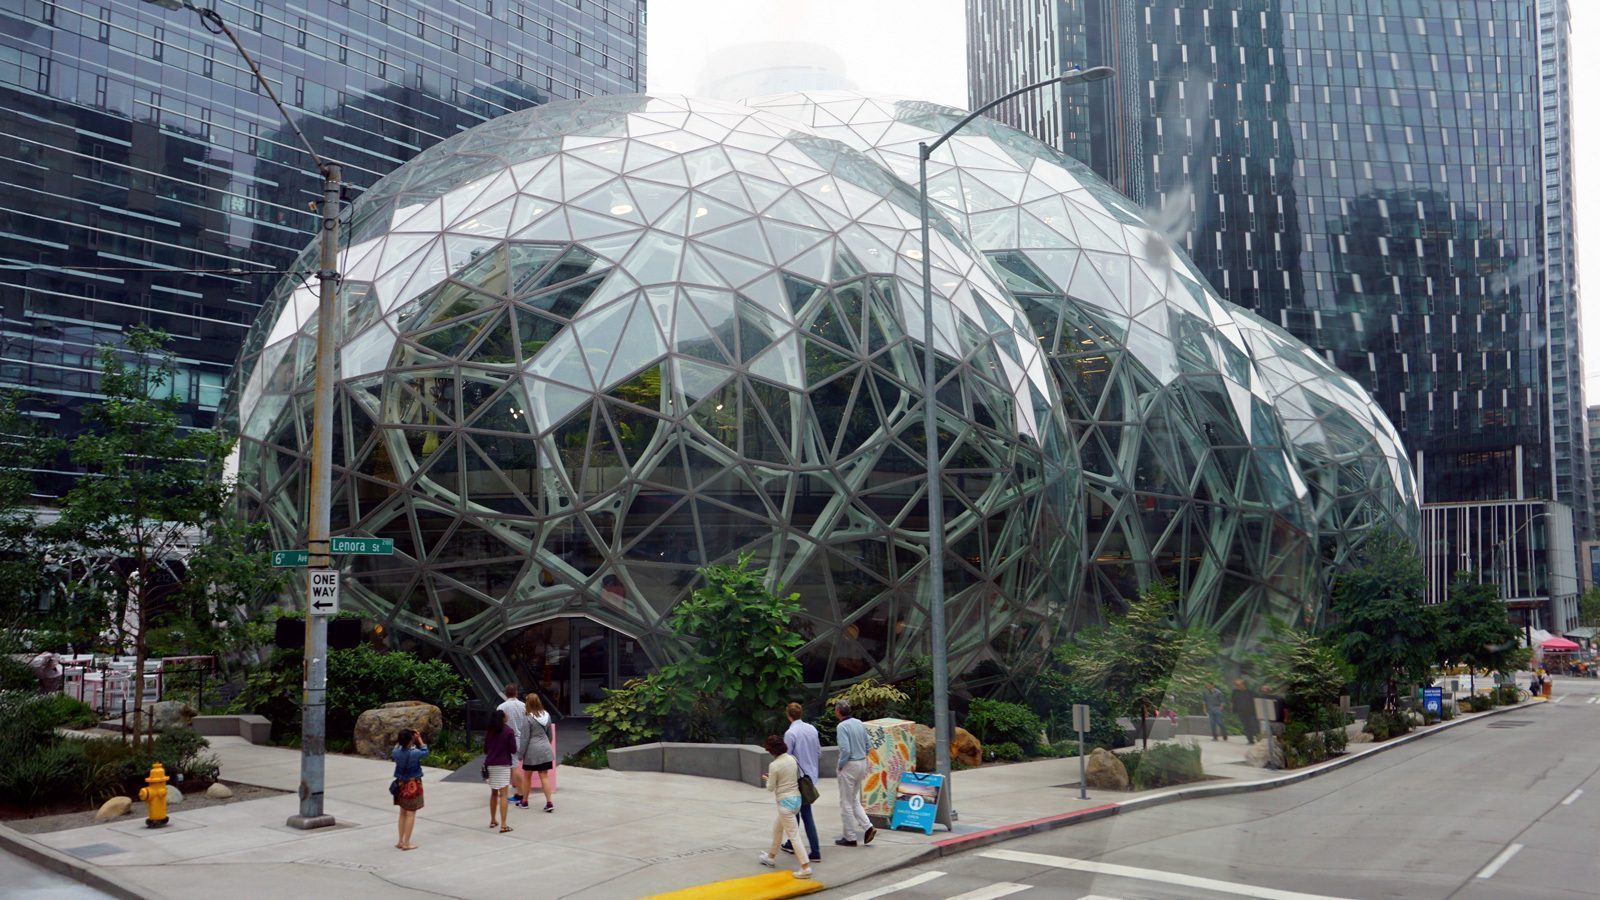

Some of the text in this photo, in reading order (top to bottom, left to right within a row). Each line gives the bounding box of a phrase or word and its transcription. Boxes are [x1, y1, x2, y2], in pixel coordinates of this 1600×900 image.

[333, 539, 365, 551] Lenora
[372, 544, 379, 552] St
[297, 554, 307, 562] Ave
[313, 575, 335, 585] ONE
[313, 587, 336, 597] WAY
